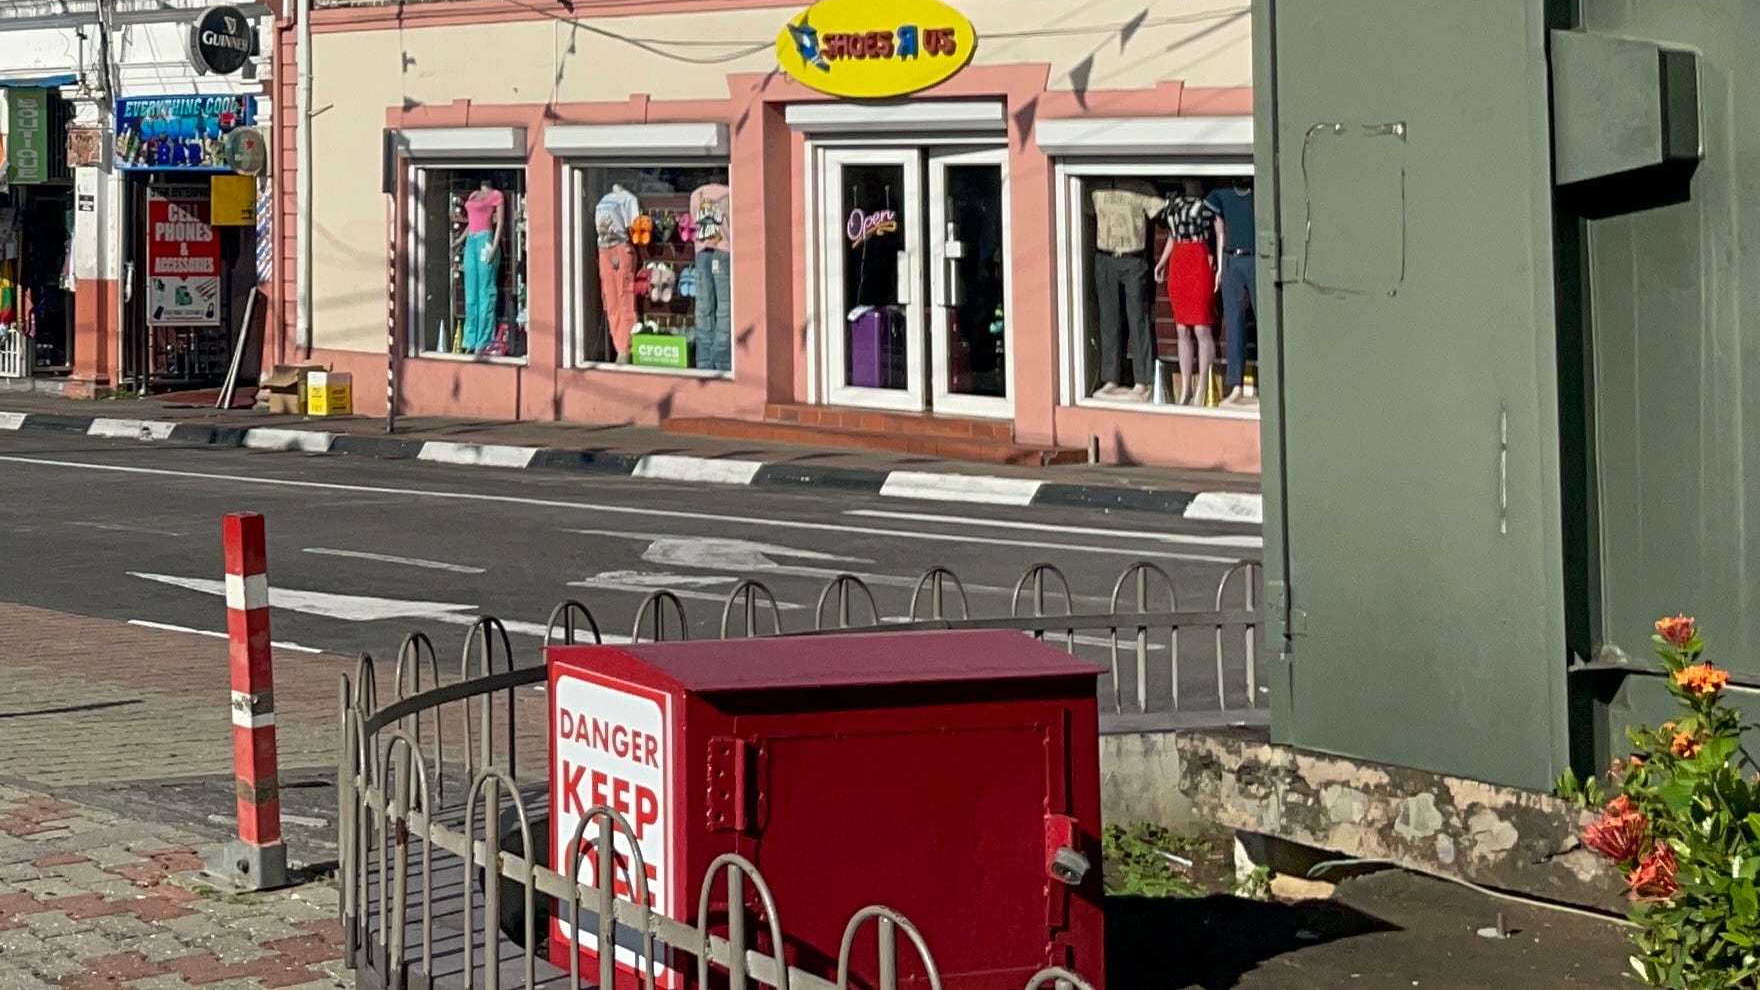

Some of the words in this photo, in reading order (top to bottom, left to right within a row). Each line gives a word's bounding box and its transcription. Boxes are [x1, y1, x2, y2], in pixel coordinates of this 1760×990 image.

[820, 30, 895, 62] SHOES
[922, 27, 957, 58] US
[123, 98, 202, 118] EVERYTHING
[16, 97, 39, 179] BOUTIQUE
[167, 202, 200, 222] CELL
[847, 208, 896, 241] Open
[154, 222, 213, 242] PHONES
[180, 242, 189, 257] &
[638, 344, 680, 358] crocs
[560, 707, 659, 769] DANGER
[562, 760, 659, 841] KEEP
